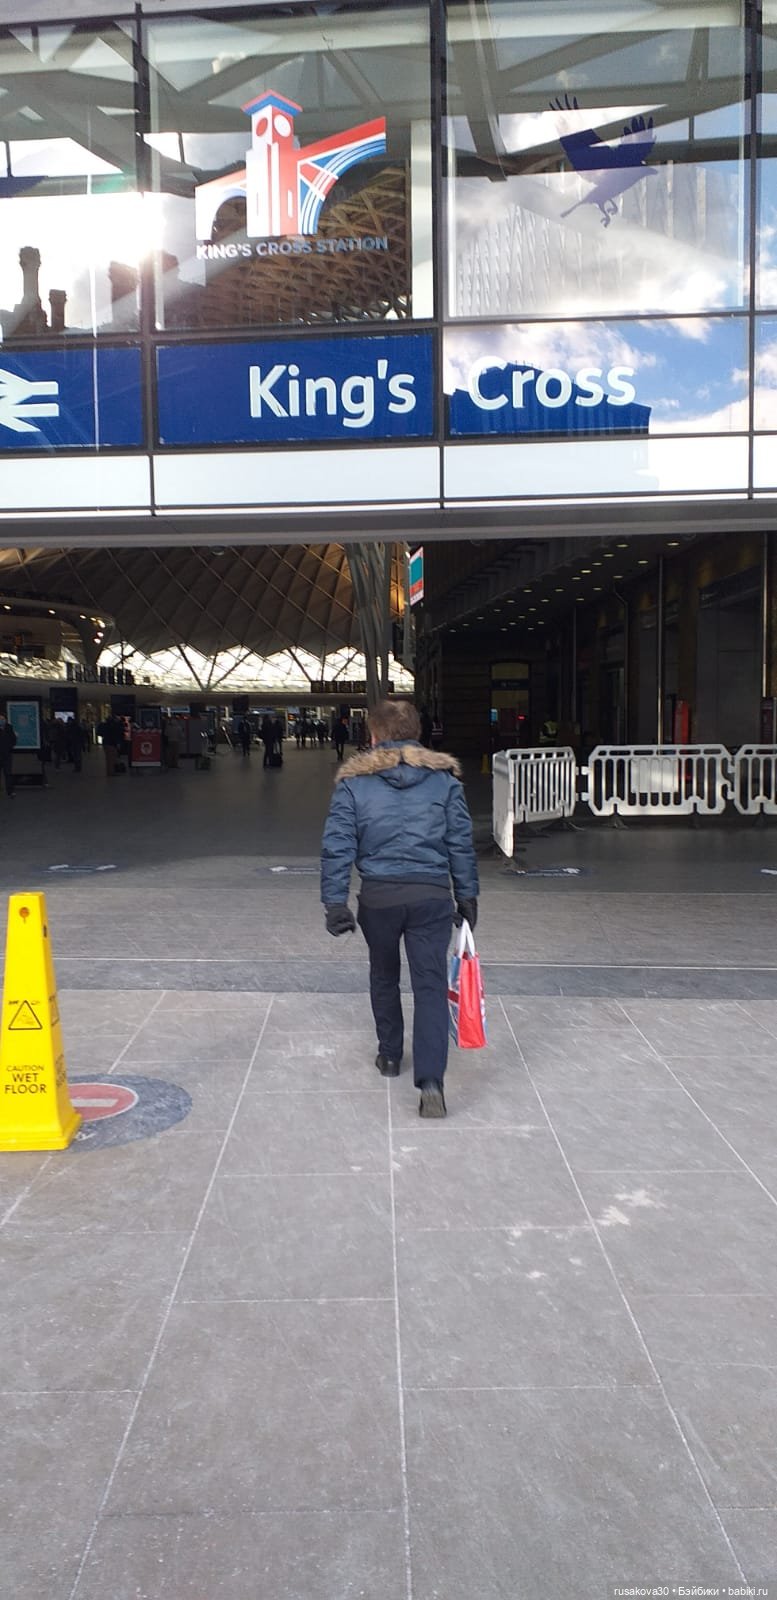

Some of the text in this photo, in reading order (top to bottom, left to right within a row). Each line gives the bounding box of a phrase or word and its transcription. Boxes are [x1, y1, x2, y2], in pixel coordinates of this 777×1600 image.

[196, 235, 388, 260] KING'S CROSS STATION
[249, 356, 635, 428] King's Cross
[12, 1073, 39, 1082] WET
[4, 1084, 47, 1094] FLOOR
